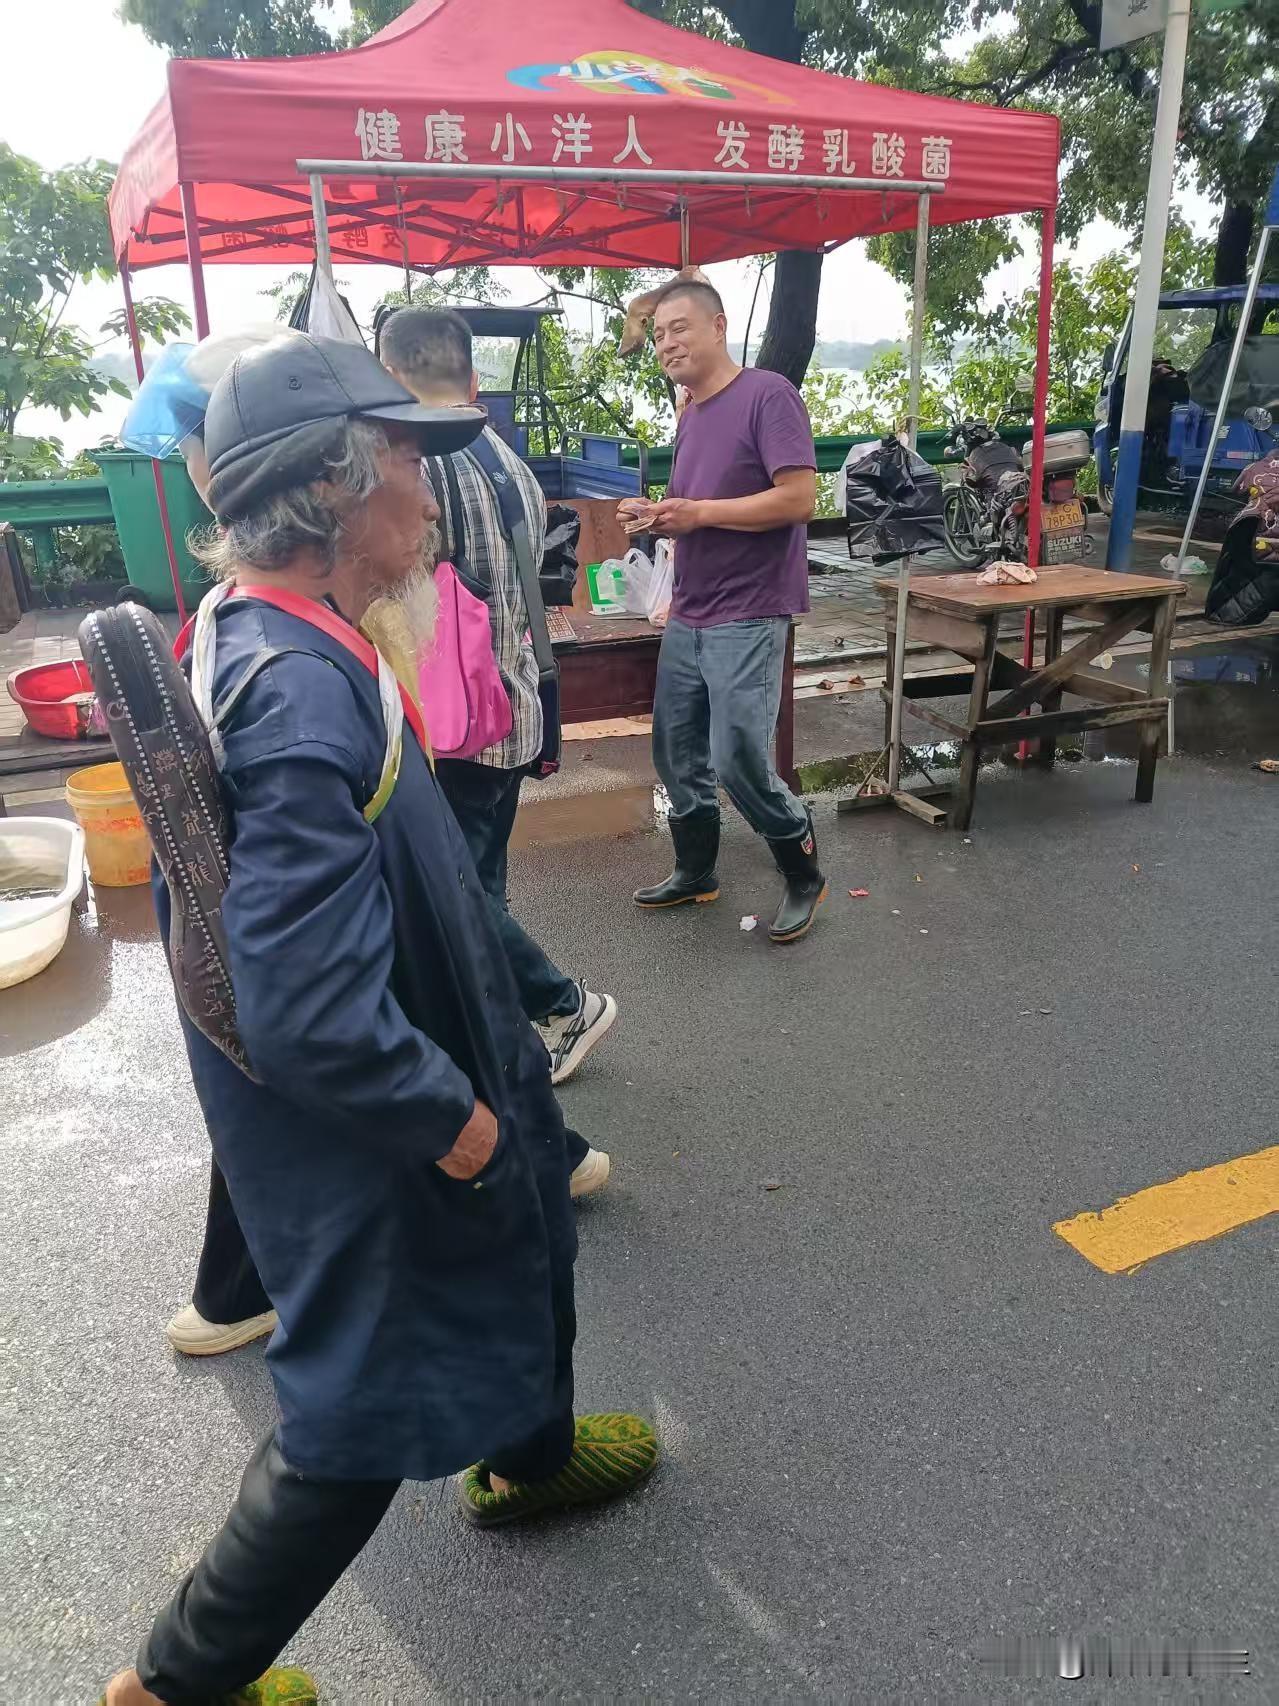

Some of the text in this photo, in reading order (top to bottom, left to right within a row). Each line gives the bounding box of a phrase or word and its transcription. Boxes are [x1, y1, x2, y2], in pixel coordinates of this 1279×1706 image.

[355, 108, 953, 180] 健康小洋人 发酵乳酸菌
[1047, 535, 1082, 548] SUZUKI
